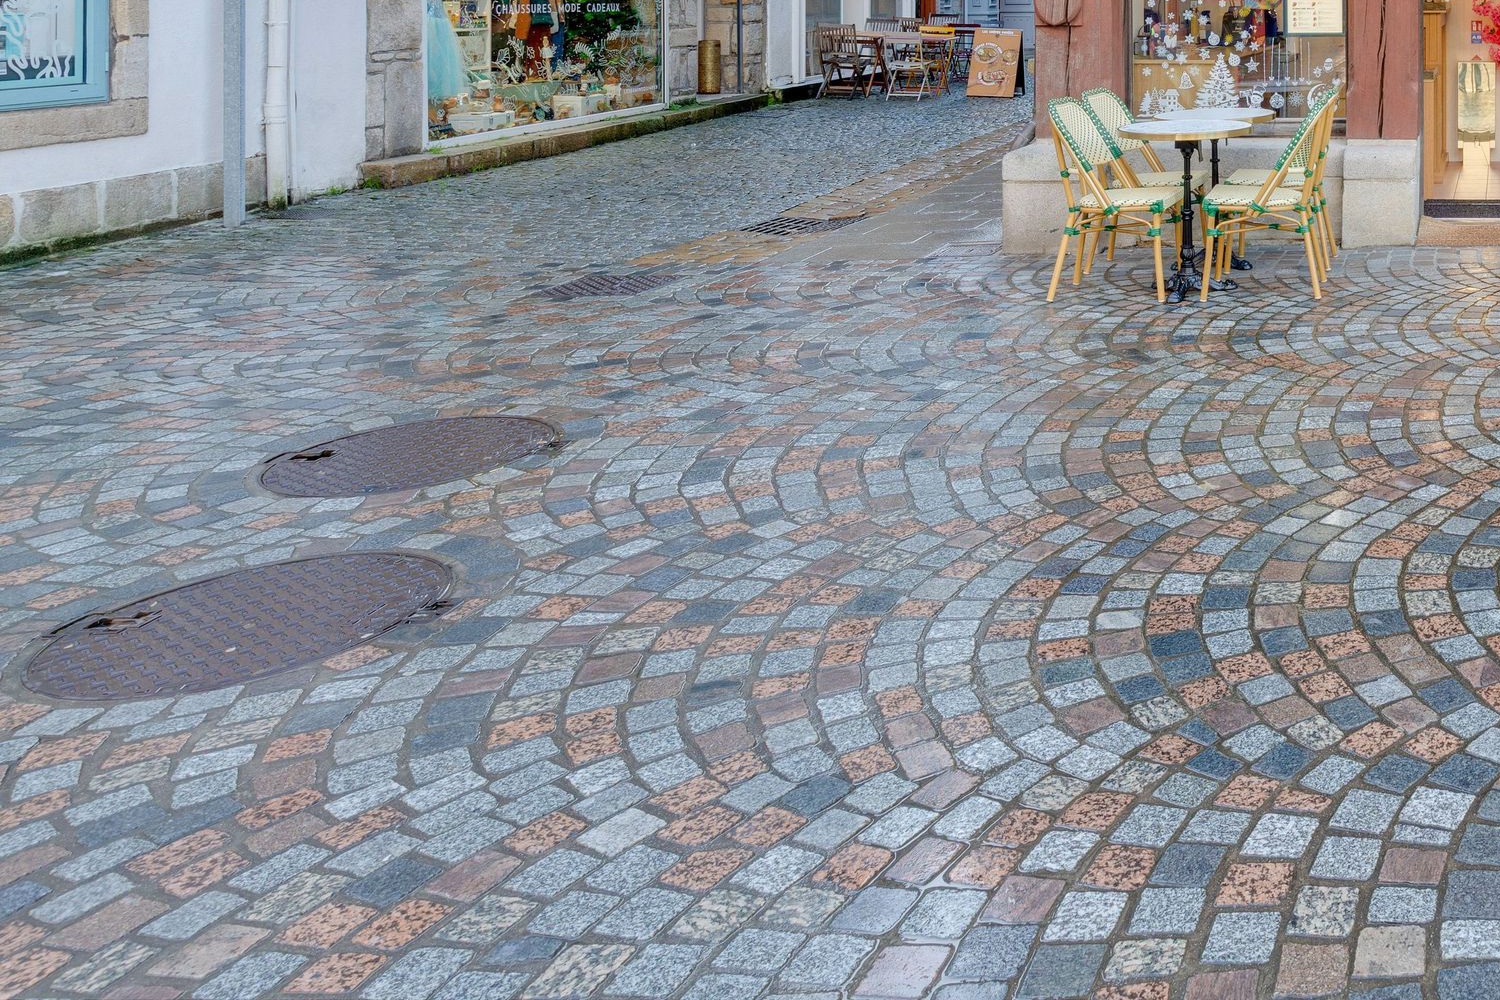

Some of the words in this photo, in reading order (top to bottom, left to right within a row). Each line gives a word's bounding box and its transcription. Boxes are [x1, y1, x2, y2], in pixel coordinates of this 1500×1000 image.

[495, 2, 552, 15] CHAUSSURES
[559, 2, 581, 13] MODE
[586, 2, 620, 13] CADEAUX
